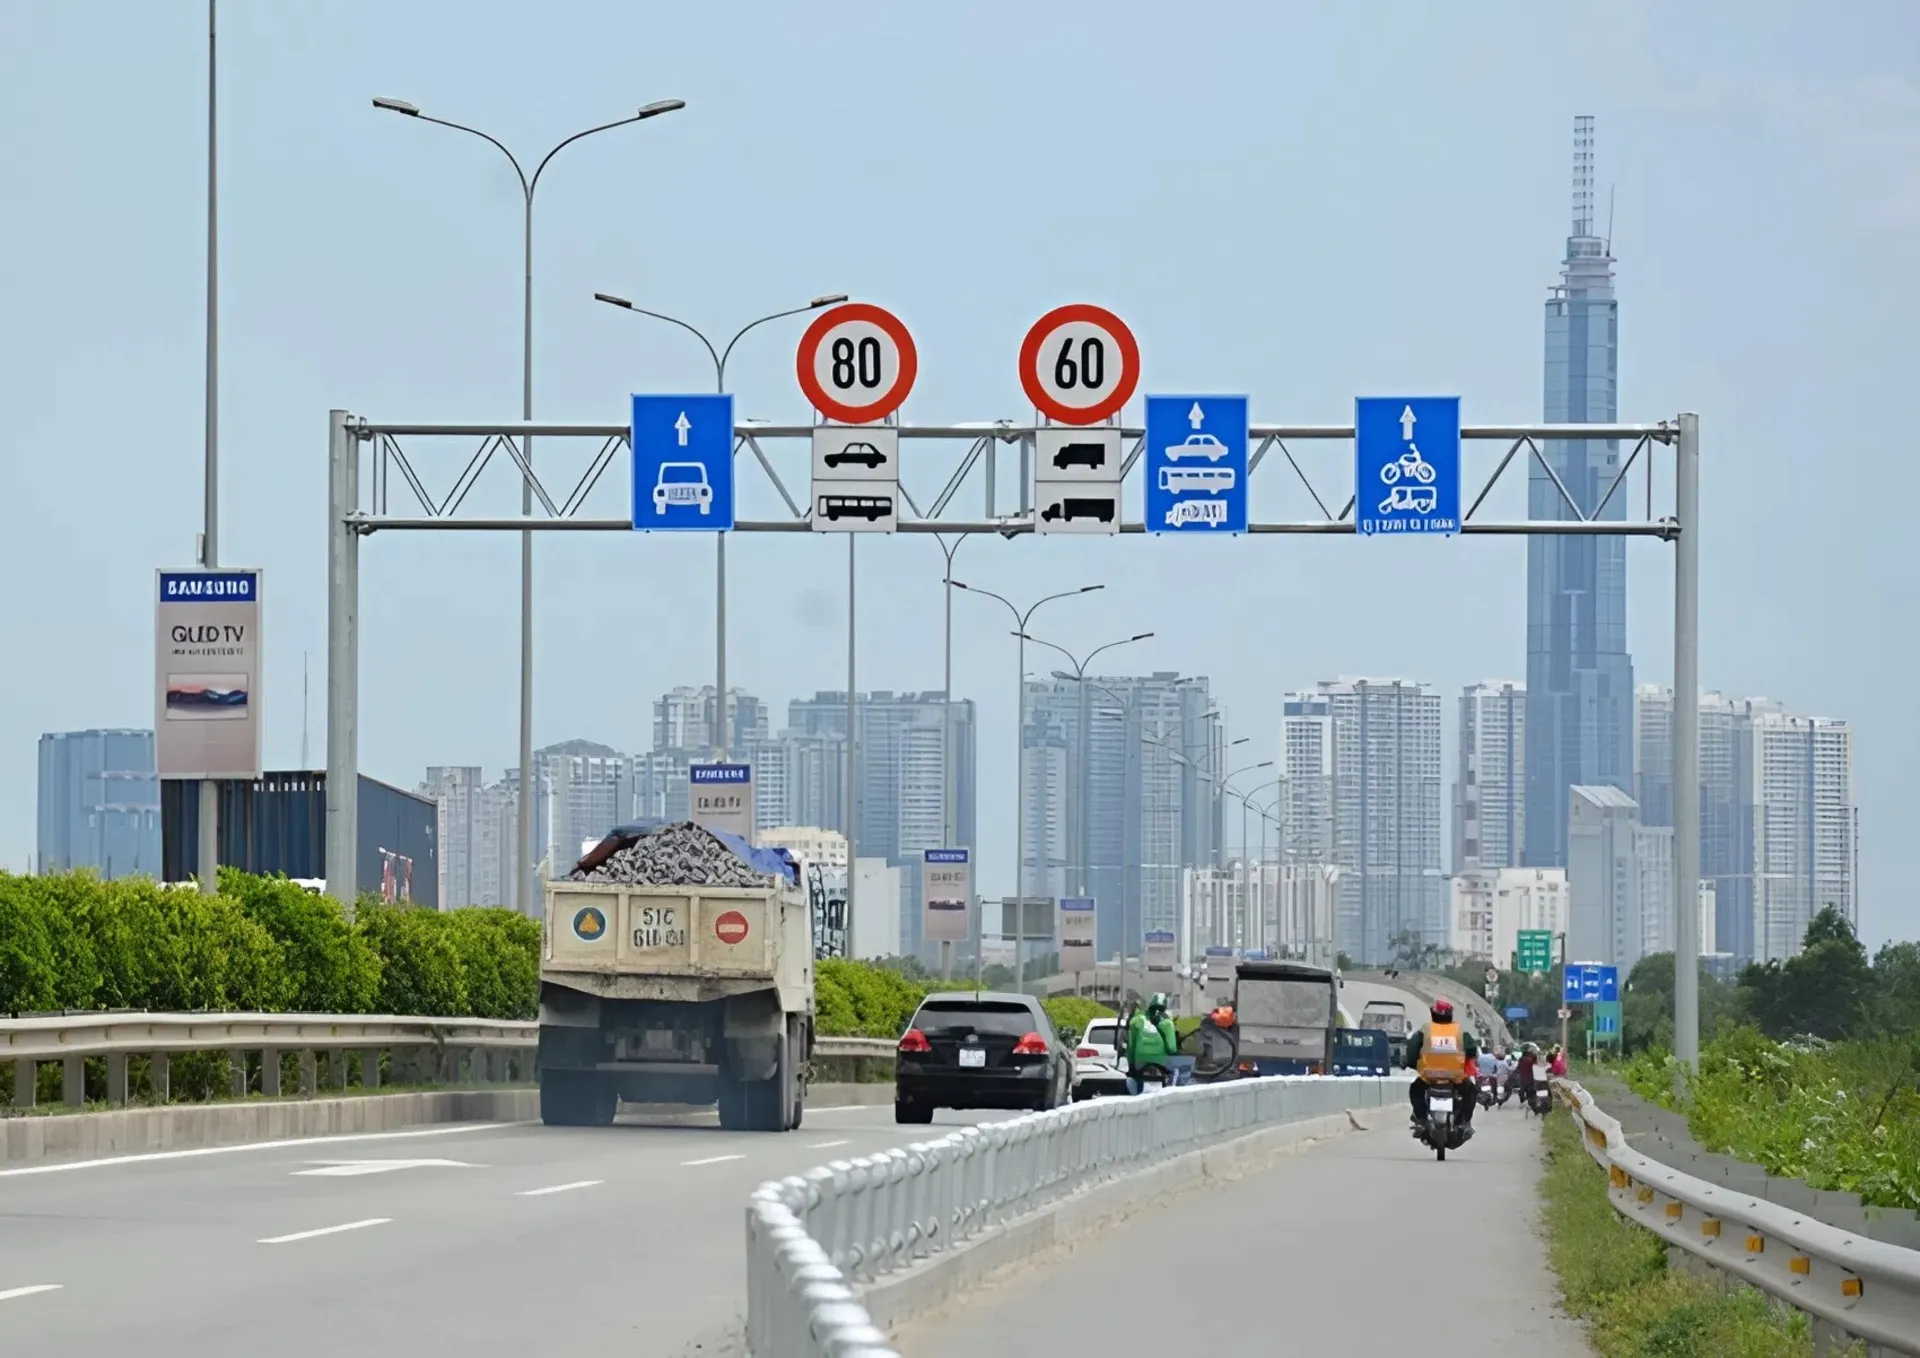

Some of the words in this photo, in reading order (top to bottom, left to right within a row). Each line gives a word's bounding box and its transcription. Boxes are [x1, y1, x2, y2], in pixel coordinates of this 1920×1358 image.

[832, 337, 881, 389] 80
[1055, 338, 1103, 389] 60
[224, 625, 244, 642] TV
